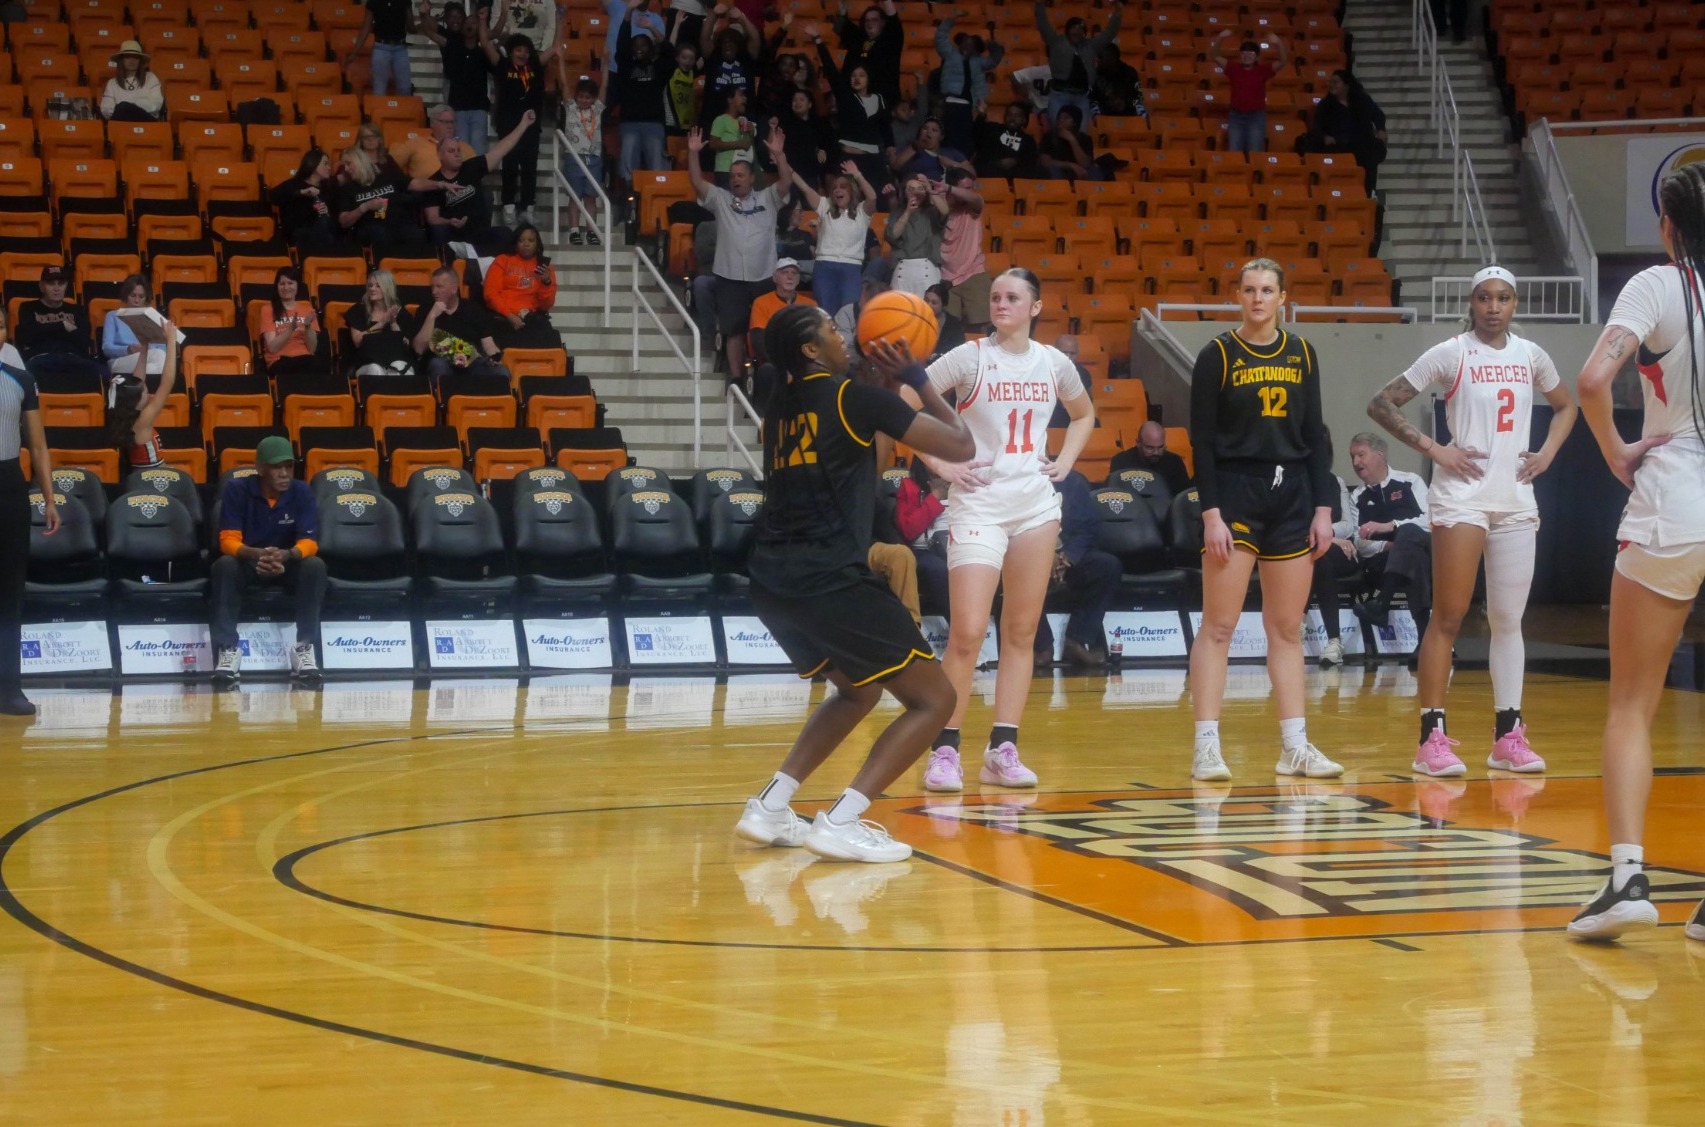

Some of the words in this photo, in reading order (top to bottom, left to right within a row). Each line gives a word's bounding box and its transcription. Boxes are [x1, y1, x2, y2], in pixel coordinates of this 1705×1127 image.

[1469, 365, 1529, 384] MERCER
[987, 382, 1050, 403] MERCER
[1258, 386, 1288, 417] 12
[1496, 388, 1515, 433] 2
[1005, 408, 1034, 454] 11
[730, 631, 772, 641] Auto-O
[1108, 625, 1179, 635] Auto-Owners
[126, 640, 206, 650] Auto-Owners
[327, 636, 407, 647] Auto-Owners
[531, 635, 606, 645] Auto-Owners
